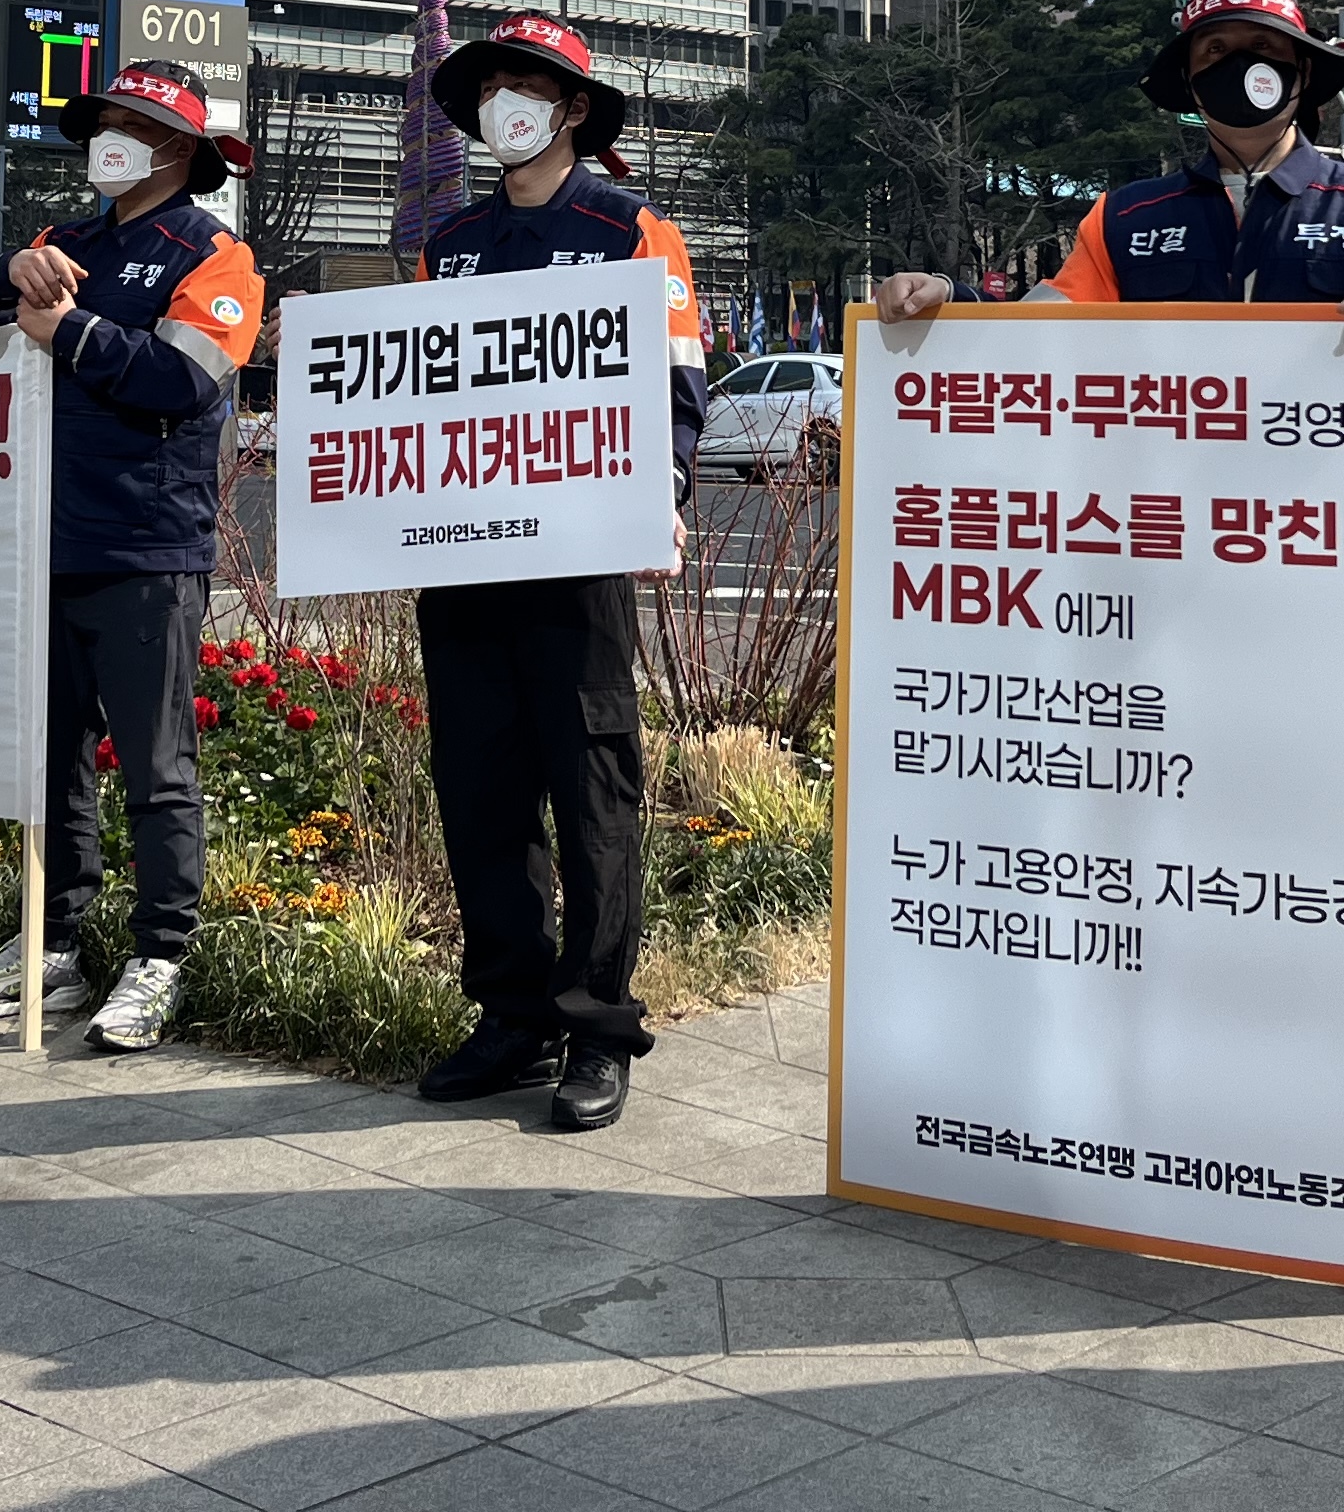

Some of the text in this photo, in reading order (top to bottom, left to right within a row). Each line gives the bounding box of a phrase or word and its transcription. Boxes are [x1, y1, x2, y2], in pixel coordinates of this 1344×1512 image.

[142, 4, 221, 47] 6701
[518, 19, 563, 47] 투쟁
[137, 76, 180, 105] 투쟁
[7, 124, 42, 139] 광화문
[1129, 226, 1187, 256] 단결
[118, 262, 165, 288] 투쟁
[308, 305, 629, 404] 국가기업 고려아연
[894, 372, 1247, 440] 약탈적·무책임
[308, 405, 632, 503] 끝까지 지켜낸다!!
[401, 517, 540, 547] 고려아연노동조합
[892, 484, 1339, 567] 홈플러스를 망친
[892, 561, 1135, 640] MBK 에게
[892, 666, 1166, 731] 국가기간산업을
[893, 729, 1193, 799] 맡기시겠습니까?
[890, 834, 966, 887] 누가
[974, 844, 1143, 910] 고용안정,
[890, 896, 1143, 973] 적임자입니까!!
[915, 1114, 1136, 1179] 전국금속노조연맹
